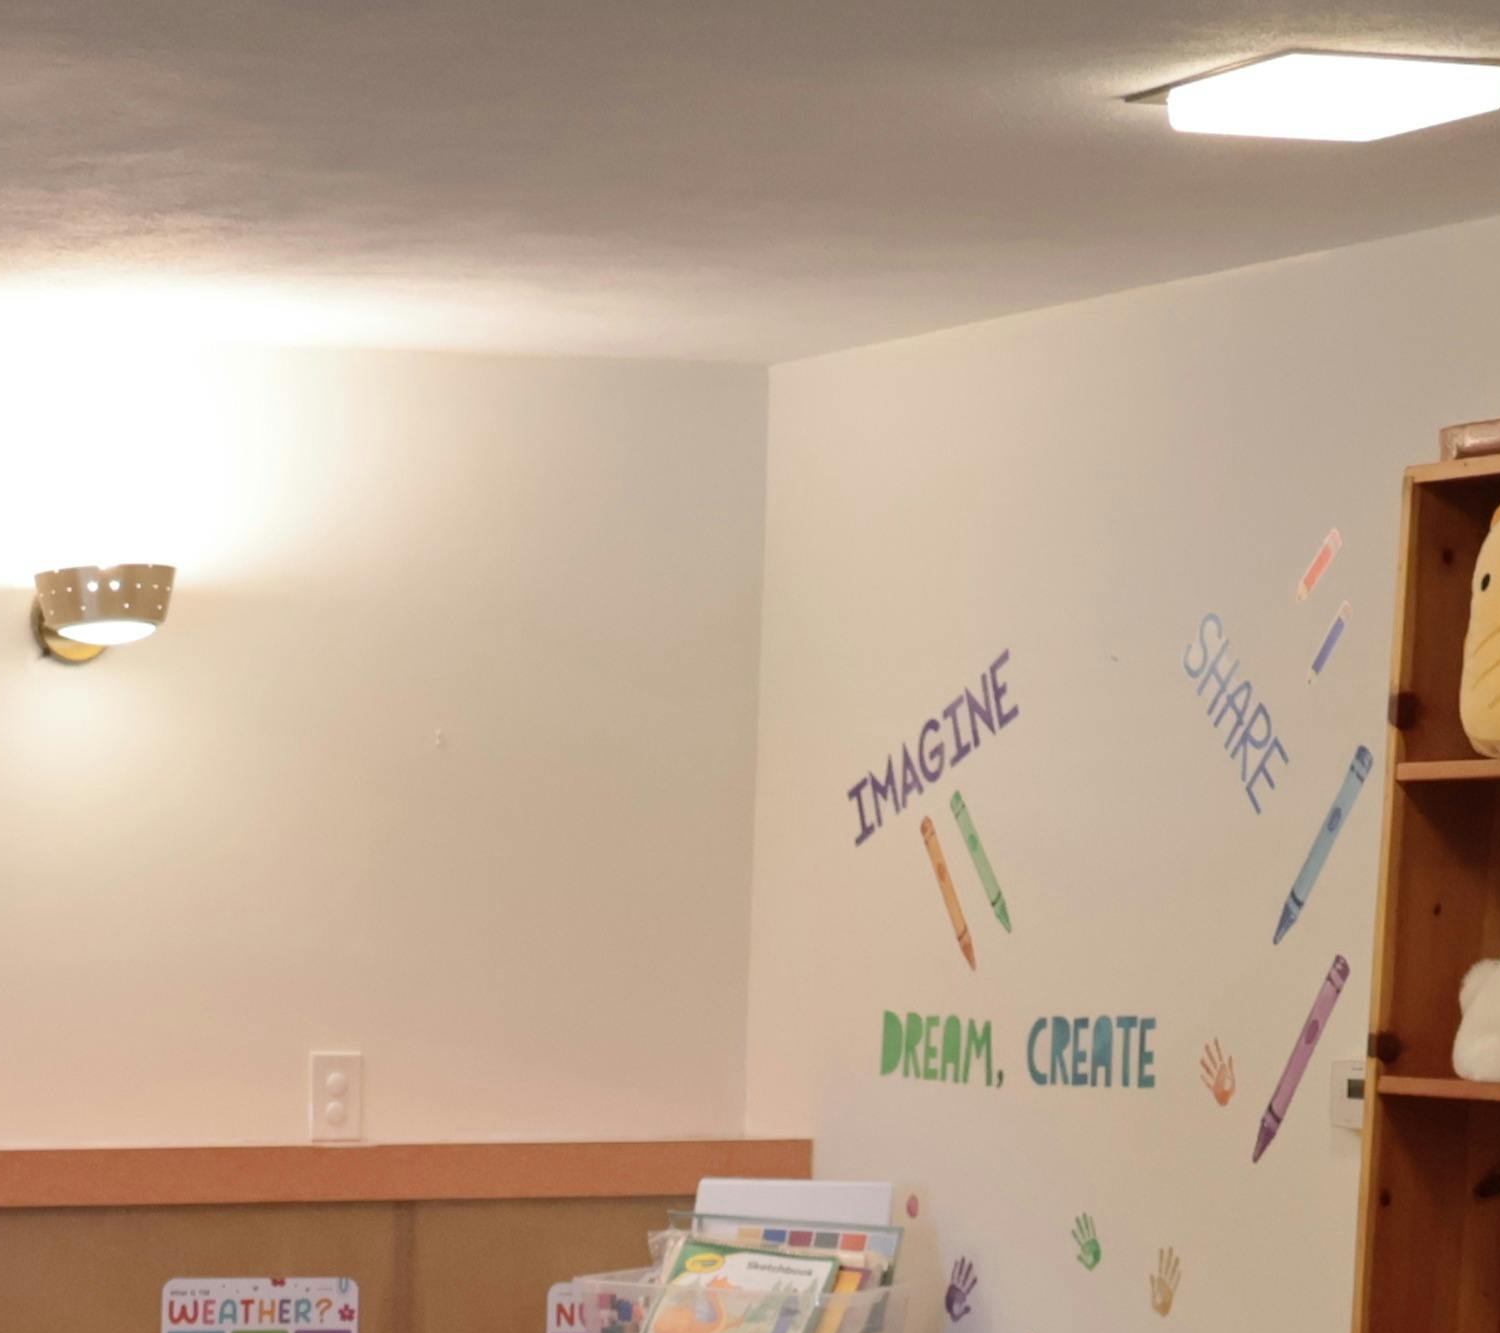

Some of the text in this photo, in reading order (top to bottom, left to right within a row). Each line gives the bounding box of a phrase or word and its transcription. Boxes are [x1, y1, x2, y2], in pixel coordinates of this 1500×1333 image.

[847, 648, 1020, 848] IMAGINE
[1180, 612, 1290, 816] SHARE
[879, 1009, 1157, 1089] DREAM, CREATE
[746, 1260, 813, 1277] Sketchbook
[168, 1298, 333, 1325] WEATHER?
